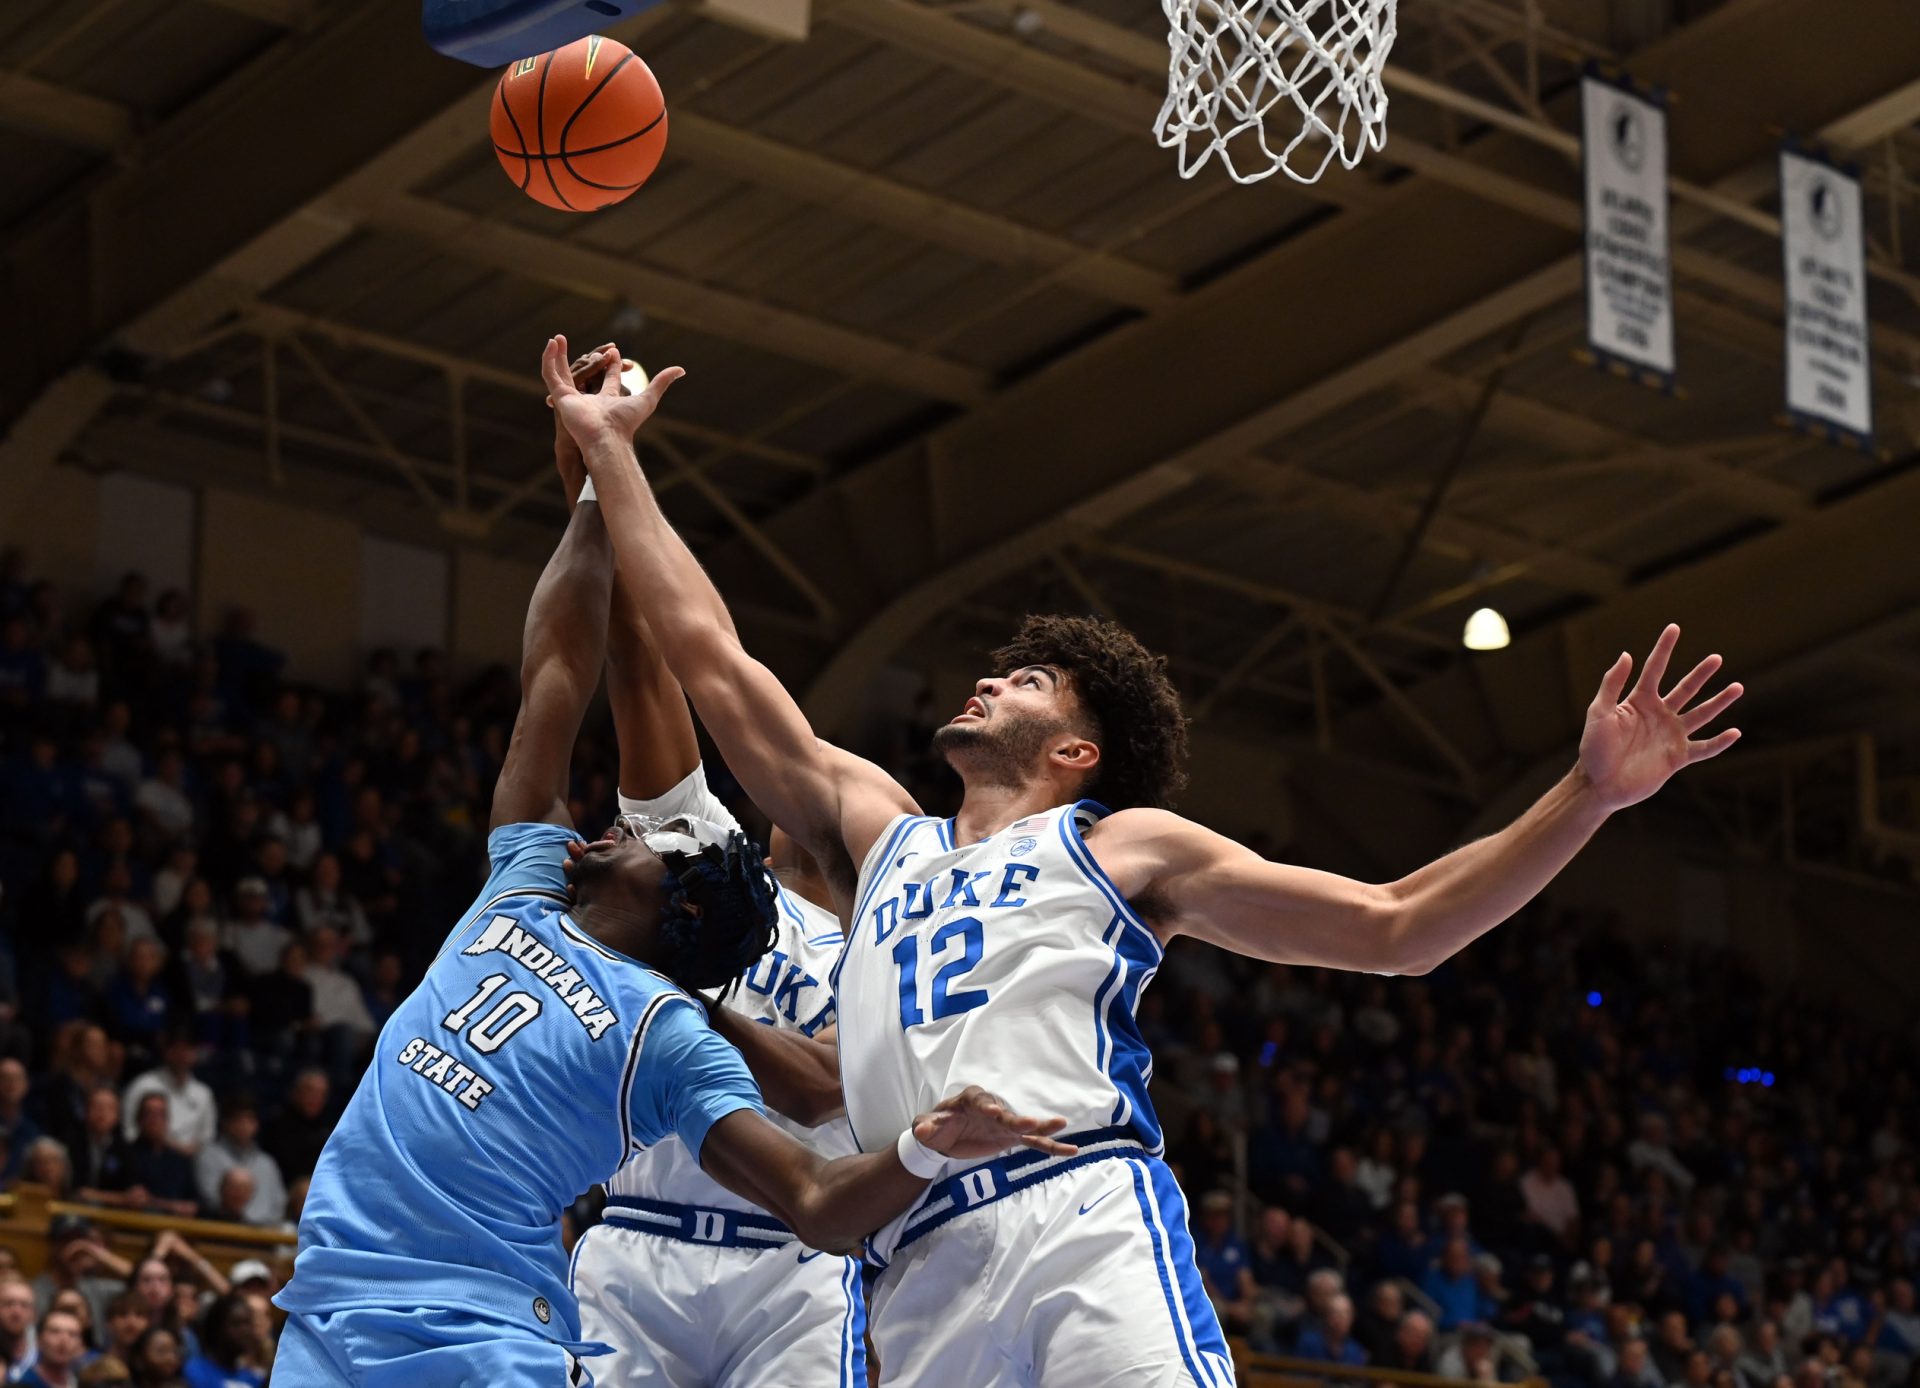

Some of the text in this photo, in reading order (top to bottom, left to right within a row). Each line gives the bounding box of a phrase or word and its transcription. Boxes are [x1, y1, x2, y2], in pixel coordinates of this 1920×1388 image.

[873, 862, 1039, 947] DUKE
[892, 916, 989, 1032] 12
[440, 973, 543, 1056] 10
[398, 1037, 496, 1112] STATE
[692, 1211, 726, 1242] D
[960, 1168, 997, 1207] D
